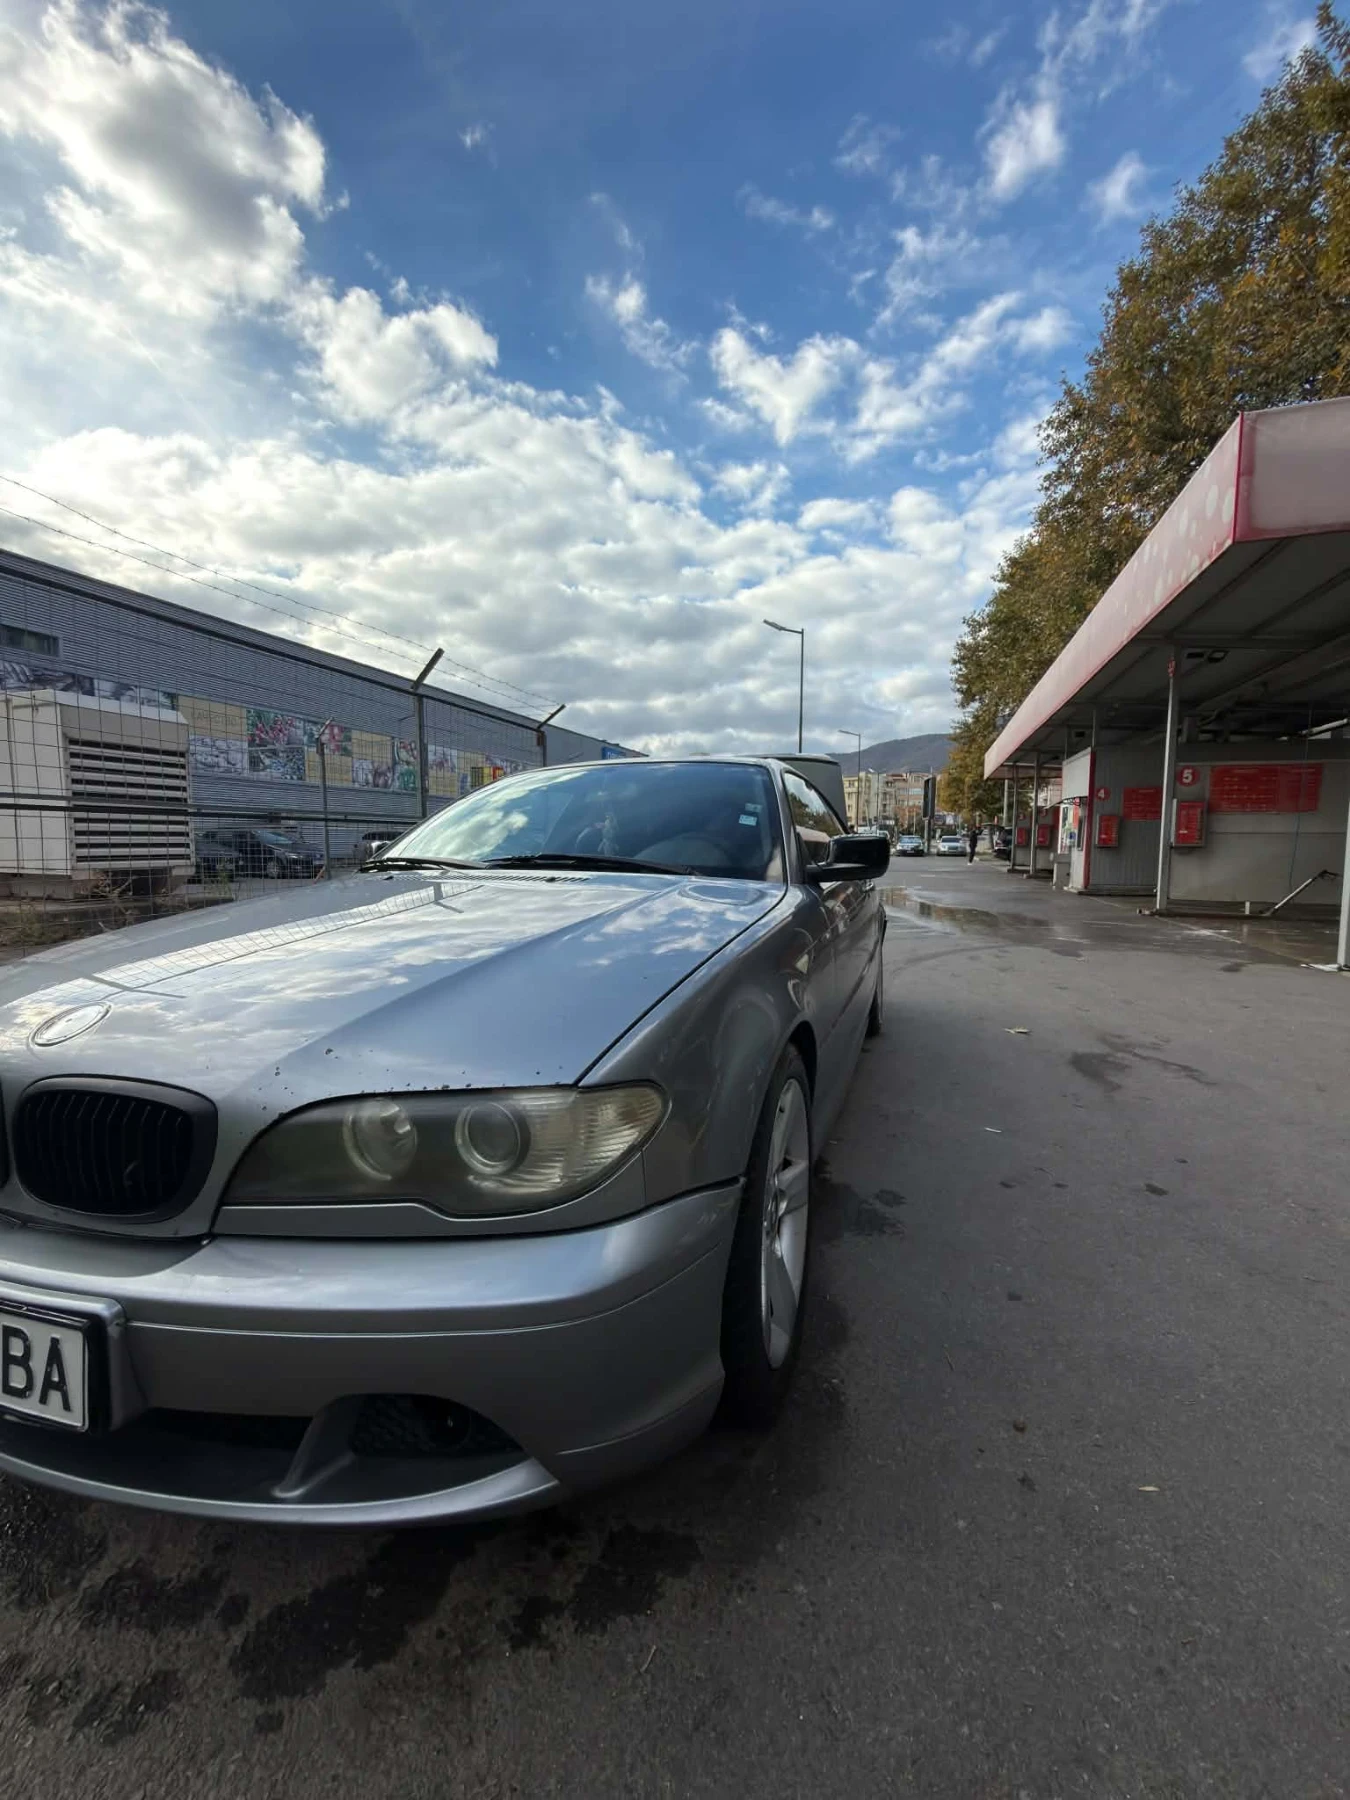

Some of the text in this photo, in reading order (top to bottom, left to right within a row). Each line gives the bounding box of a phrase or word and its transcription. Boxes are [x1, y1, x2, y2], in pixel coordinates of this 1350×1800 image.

[1182, 769, 1193, 783] 5
[1097, 788, 1105, 799] 4
[2, 1324, 71, 1412] BA
